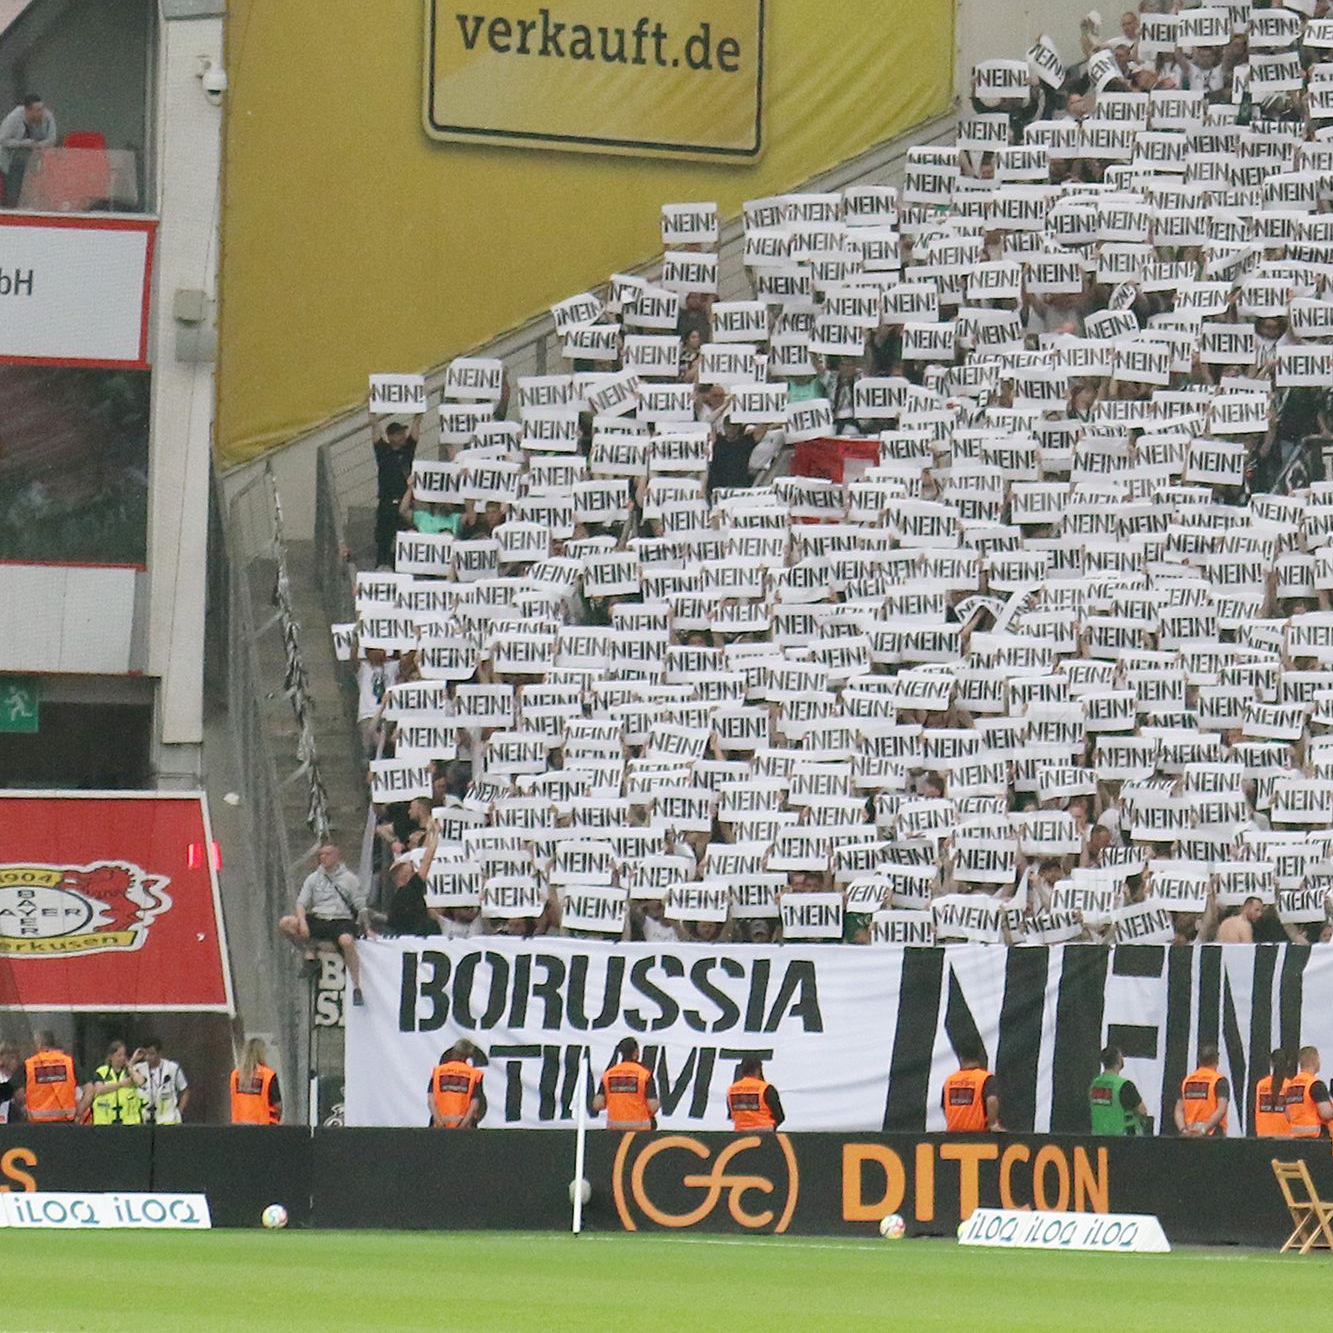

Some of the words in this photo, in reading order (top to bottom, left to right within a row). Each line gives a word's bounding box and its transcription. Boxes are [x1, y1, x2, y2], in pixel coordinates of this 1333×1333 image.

[456, 8, 742, 73] verkauft.de
[846, 196, 895, 214] NEIN!
[664, 213, 715, 233] NEIN!
[716, 311, 764, 331] NEIN!
[1201, 333, 1253, 352] NEIN!
[372, 384, 423, 402] NEIN!
[738, 393, 786, 412] NEIN!
[856, 388, 906, 407] NEIN!
[1190, 451, 1240, 473] NEIN!
[574, 490, 626, 511] NEIN!
[1161, 617, 1215, 638] NEIN!
[388, 690, 443, 709] NEIN!
[455, 695, 510, 715] NEIN!
[374, 768, 429, 790] NEIN!
[1276, 790, 1331, 810] NEIN!
[957, 849, 1015, 871] NEIN!
[564, 895, 625, 920] NEIN!
[673, 889, 723, 909] NEIN!
[873, 922, 931, 942] NEIN!
[399, 949, 824, 1034] BORUSSIA
